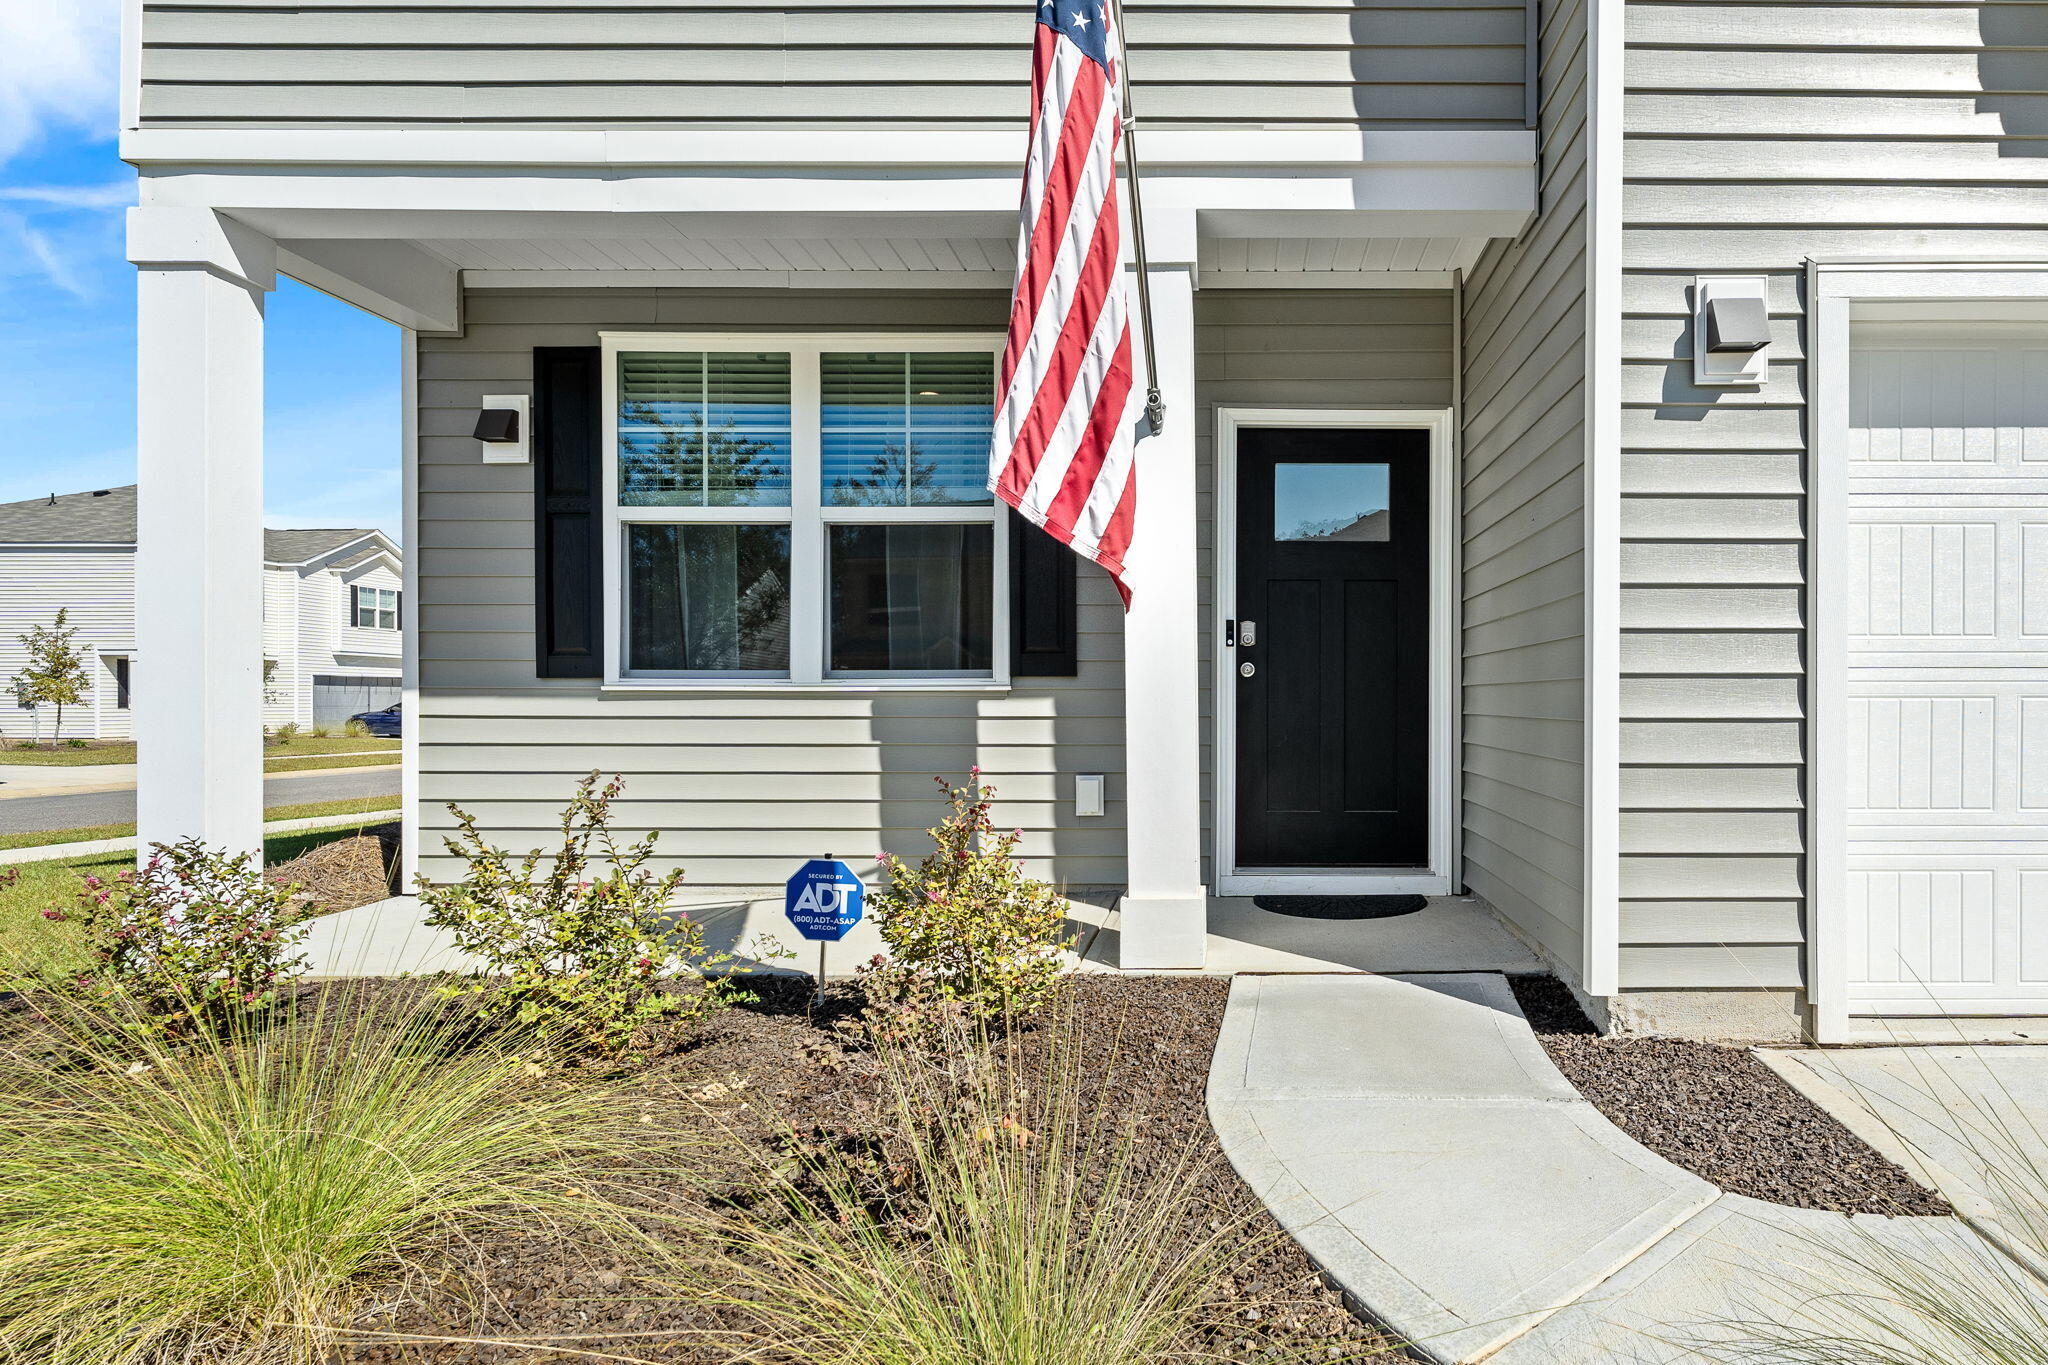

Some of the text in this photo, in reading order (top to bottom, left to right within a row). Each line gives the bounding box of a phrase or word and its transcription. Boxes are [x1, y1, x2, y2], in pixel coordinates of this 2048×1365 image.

[793, 882, 857, 914] ADT
[793, 915, 856, 925] (800) ADT-ASAP
